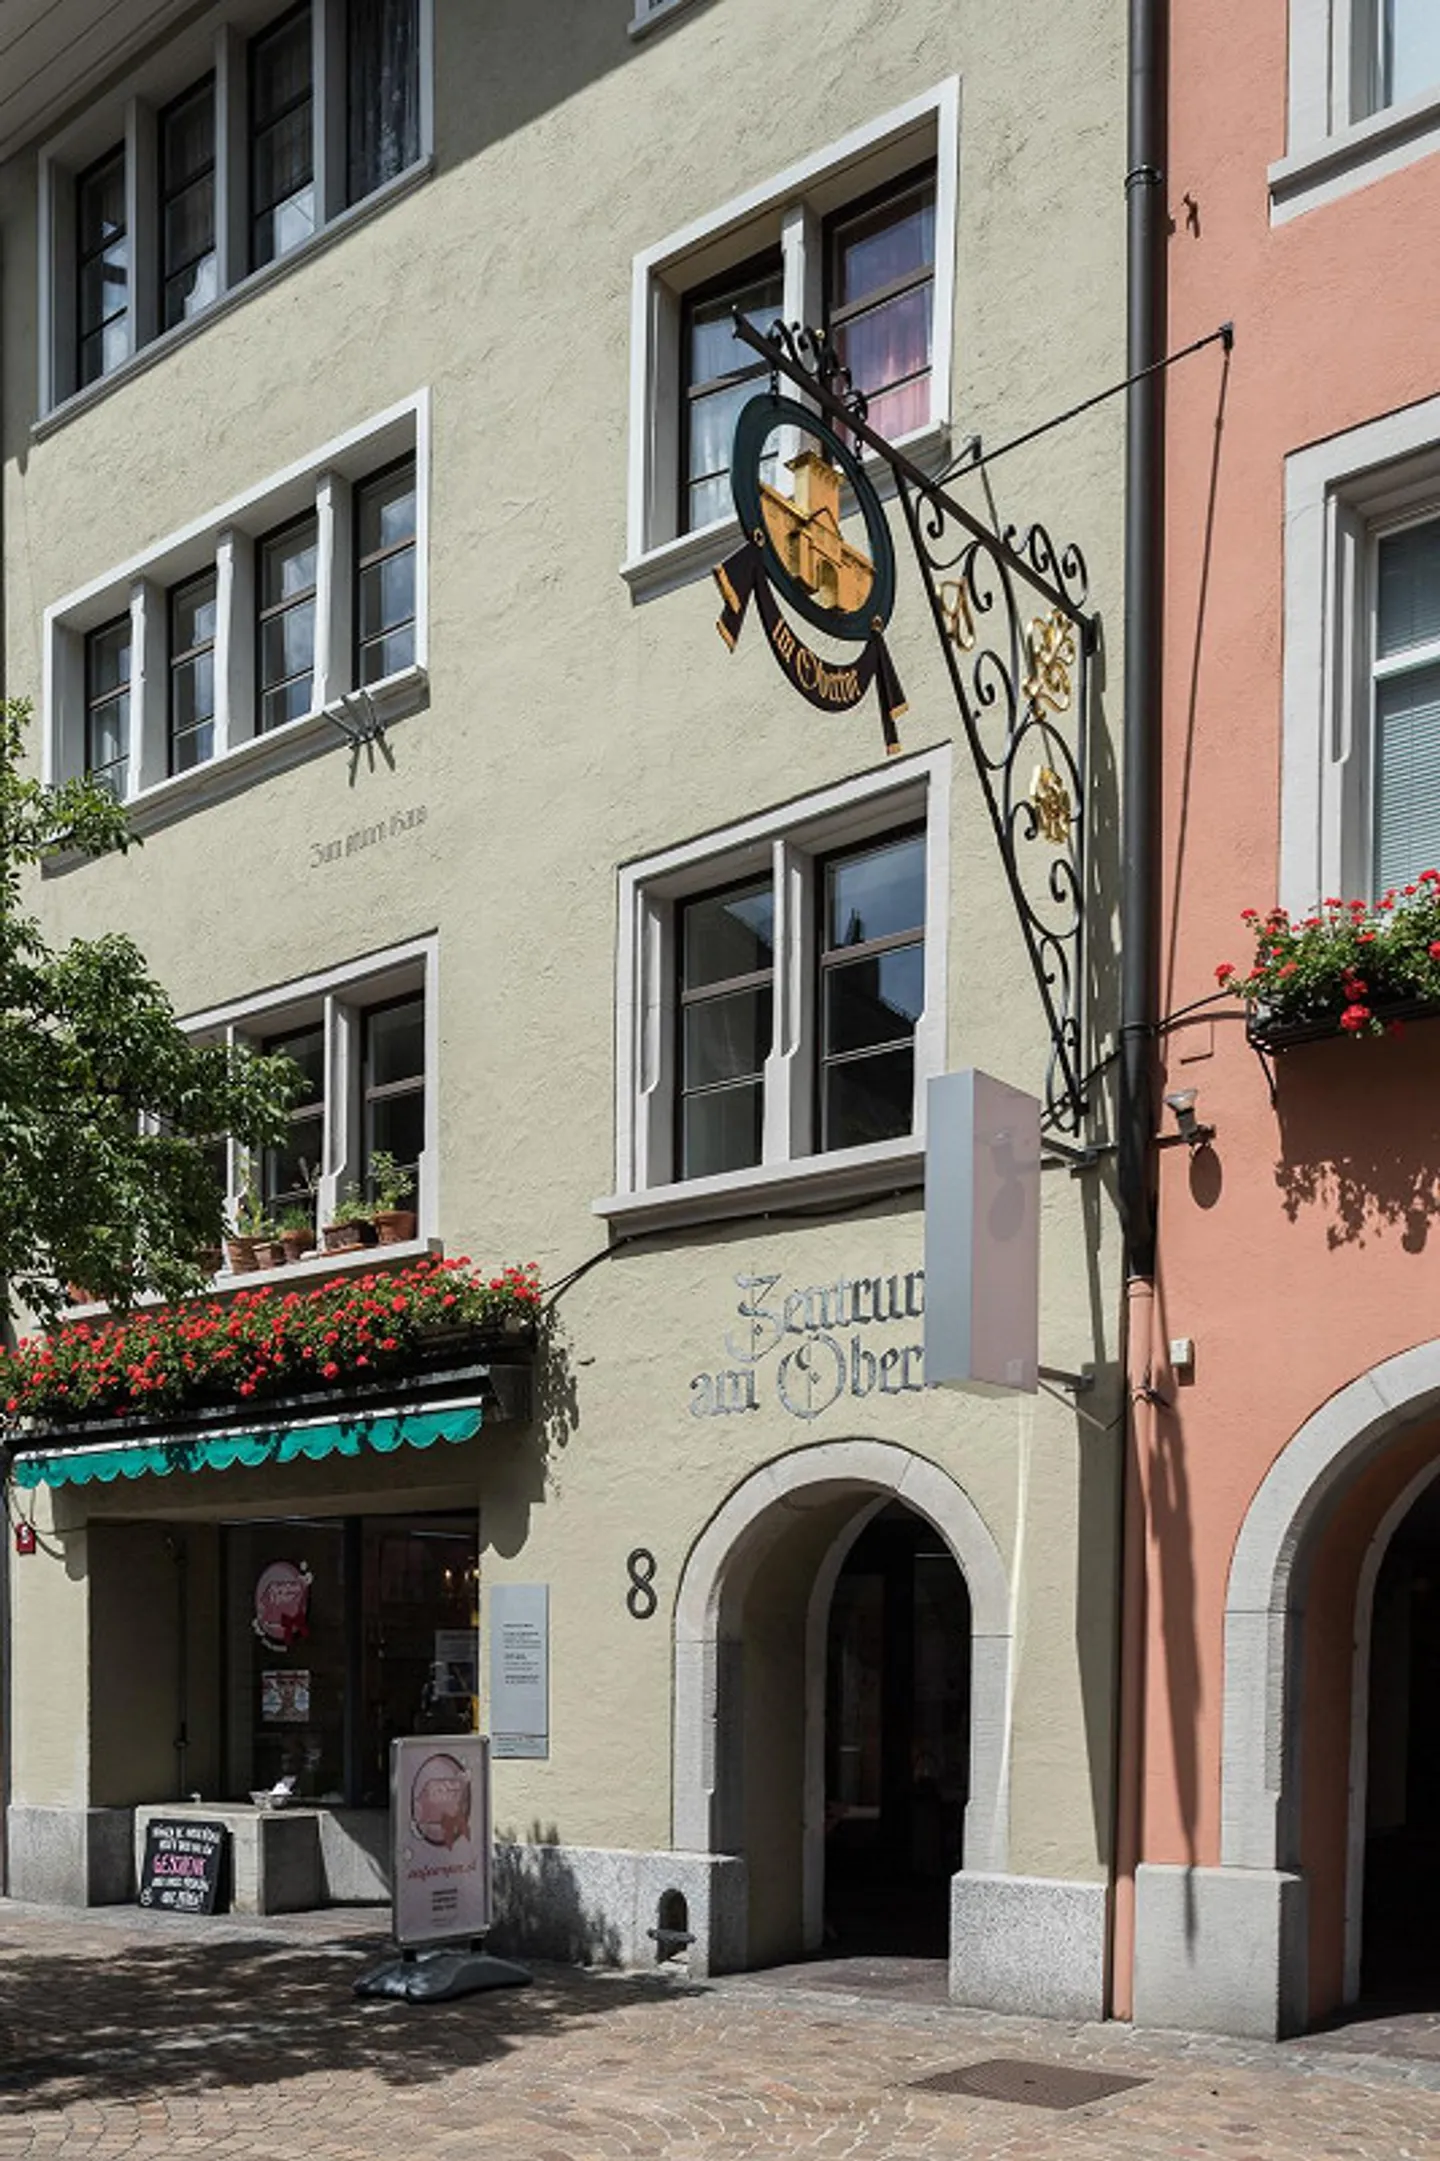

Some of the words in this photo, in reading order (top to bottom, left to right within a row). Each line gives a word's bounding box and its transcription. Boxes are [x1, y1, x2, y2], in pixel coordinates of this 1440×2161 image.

[689, 1368, 760, 1418] am
[777, 1333, 926, 1425] Ober
[626, 1547, 658, 1620] 8
